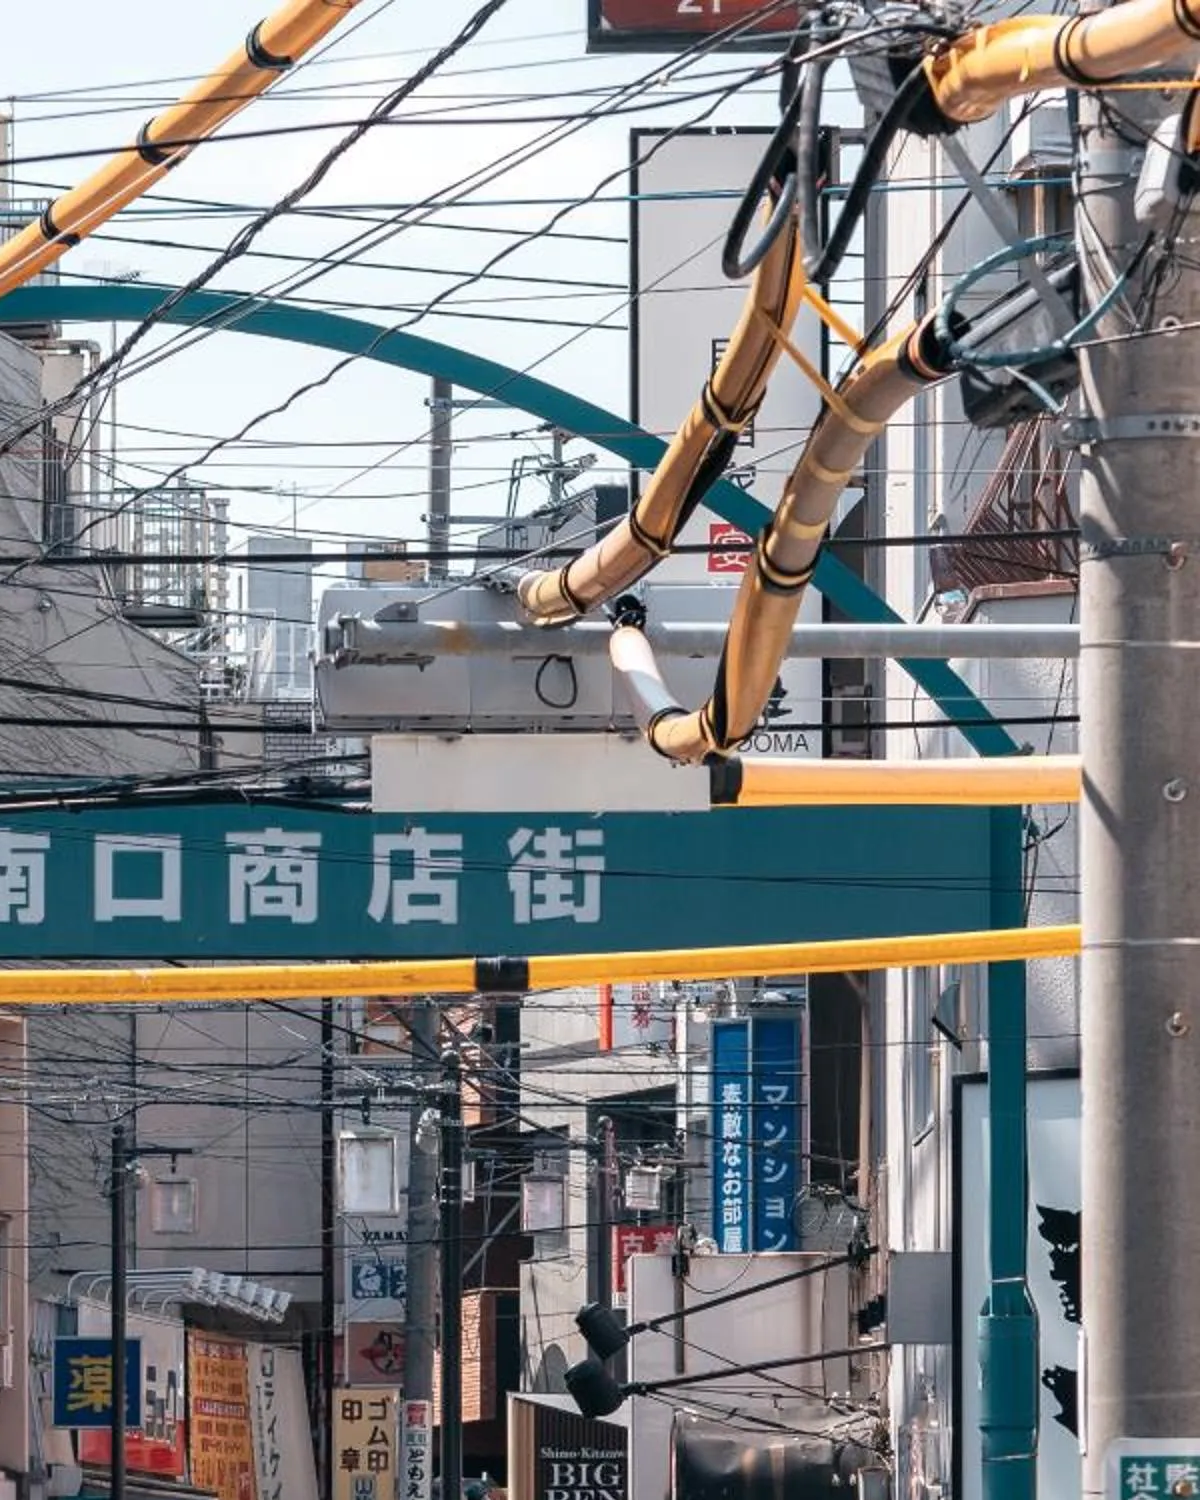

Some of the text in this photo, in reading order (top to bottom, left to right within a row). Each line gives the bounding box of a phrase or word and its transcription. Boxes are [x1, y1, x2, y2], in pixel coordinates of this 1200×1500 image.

[340, 1399, 363, 1473] 印章
[368, 1397, 391, 1473] ゴム印
[550, 1463, 621, 1488] BIG
